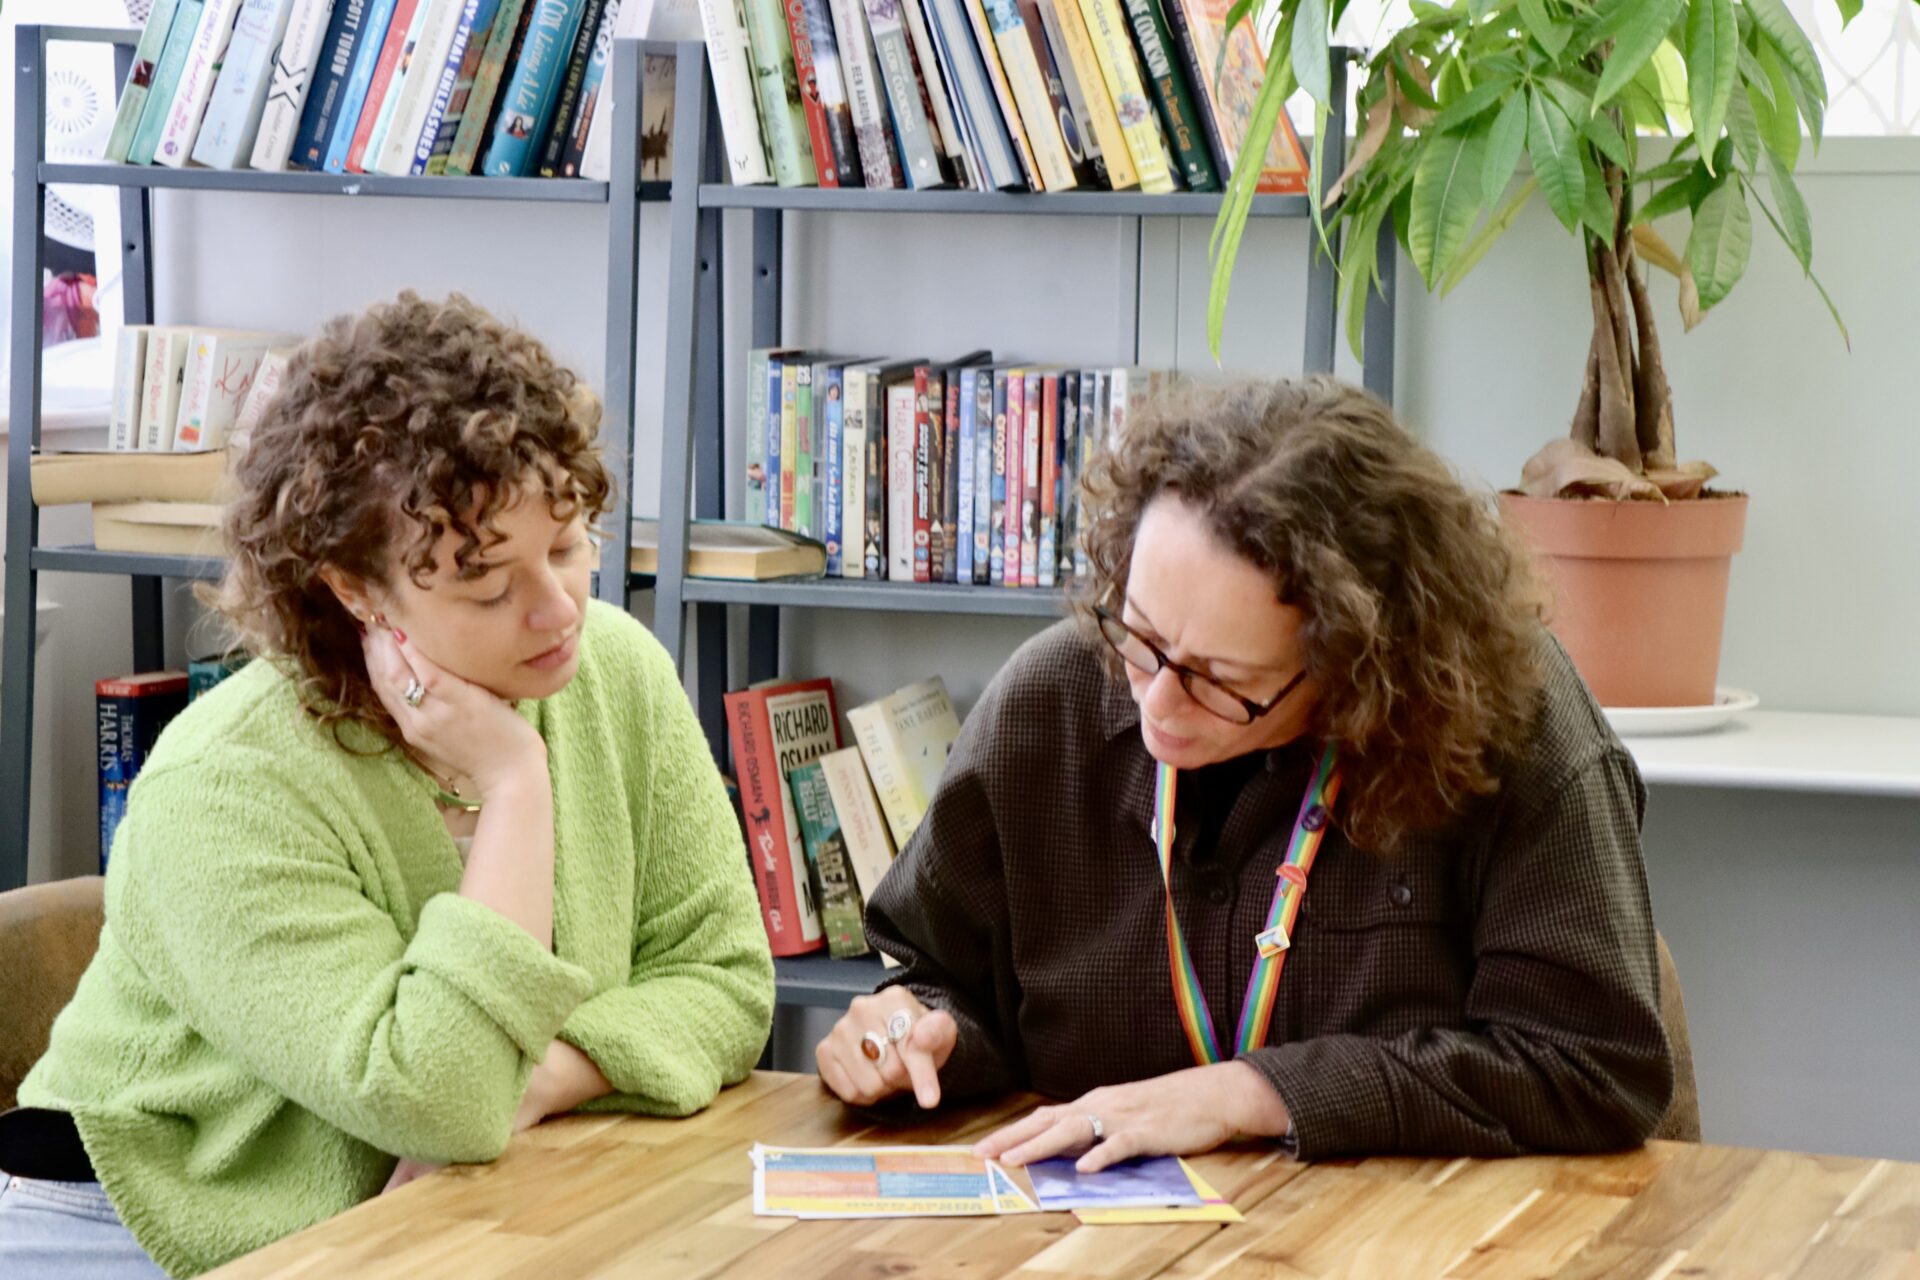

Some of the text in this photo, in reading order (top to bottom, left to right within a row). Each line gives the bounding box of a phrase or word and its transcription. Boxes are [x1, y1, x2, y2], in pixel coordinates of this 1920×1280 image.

[328, 0, 365, 77] COTT TUROW
[449, 24, 470, 63] THAI
[535, 0, 569, 31] COX
[702, 0, 729, 63] endell
[787, 0, 816, 68] OWER
[1091, 0, 1112, 36] cues
[1134, 12, 1171, 79] COOKSON
[521, 27, 555, 76] Living
[851, 64, 865, 86] BEN
[881, 38, 900, 74] SLOW
[417, 66, 456, 161] UNLEASHED
[890, 74, 916, 133] COOKING
[148, 425, 159, 445] BEN
[750, 363, 765, 453] Anita Shreve
[894, 397, 912, 493] HARLAN COBEN
[994, 413, 1006, 476] eragon
[958, 481, 974, 534] NEWS
[100, 703, 118, 772] HARRIS
[121, 714, 134, 763] THOMAS
[745, 755, 763, 805] OSMAN
[837, 766, 872, 852] PENNY APPLES
[861, 722, 915, 841] THE LOST MA
[813, 838, 849, 898] AREA
